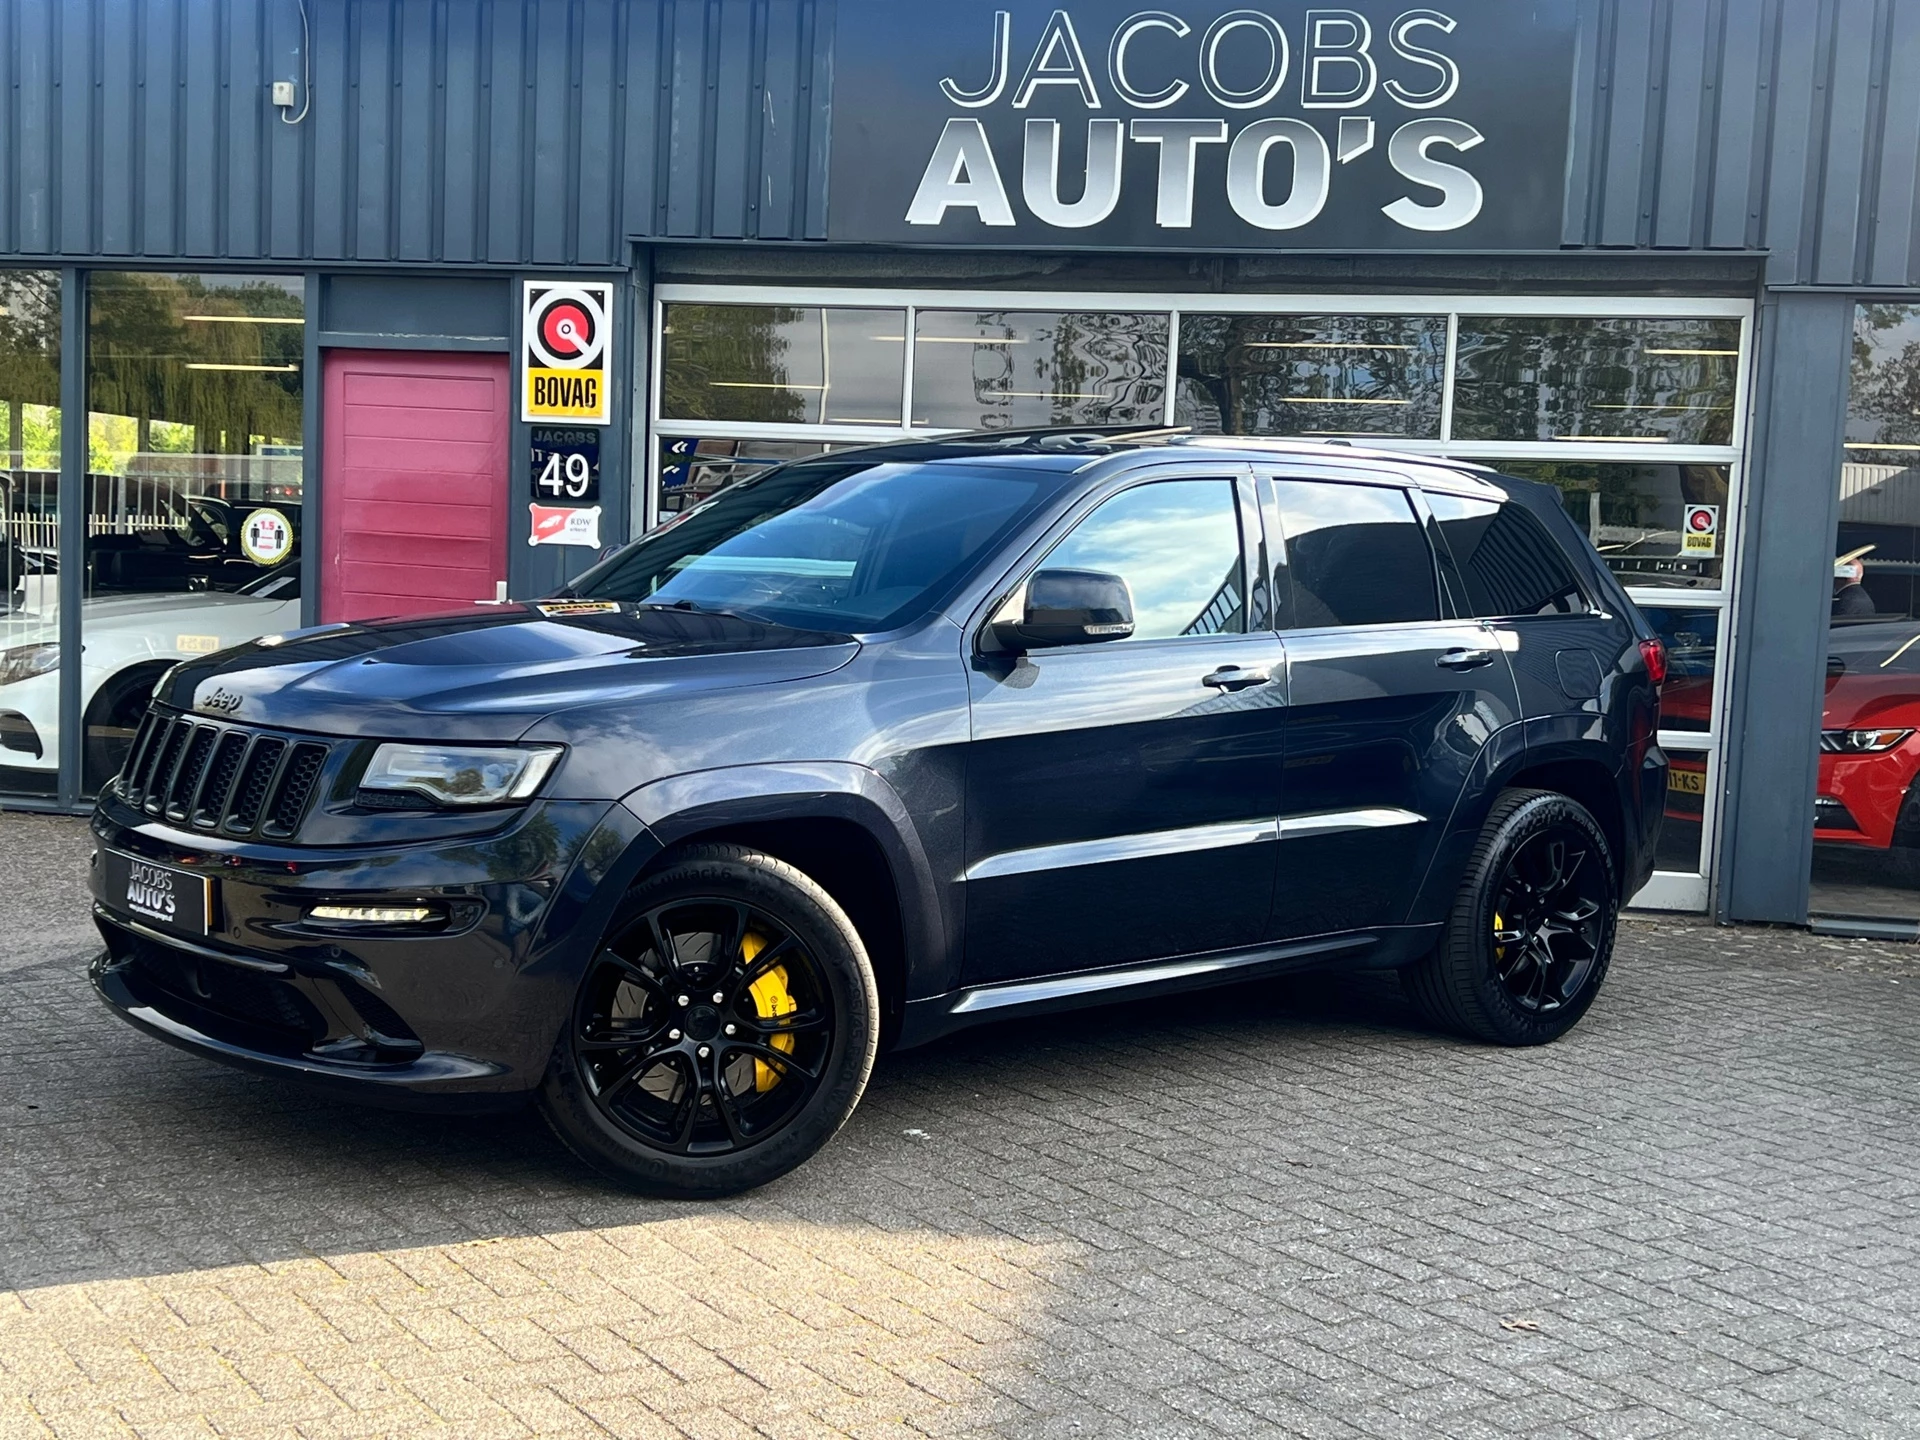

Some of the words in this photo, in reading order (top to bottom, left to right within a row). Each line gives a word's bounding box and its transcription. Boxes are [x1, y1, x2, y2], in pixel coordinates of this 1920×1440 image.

[938, 8, 1460, 110] JACOBS
[904, 115, 1485, 231] AUTO'S
[534, 376, 597, 408] BOVAG
[533, 429, 597, 445] JACOBS
[539, 452, 589, 498] 49
[1686, 536, 1712, 548] BOVAG
[203, 687, 243, 714] Jeep
[129, 861, 173, 891] JACOBS
[127, 880, 176, 914] AUTO'S
